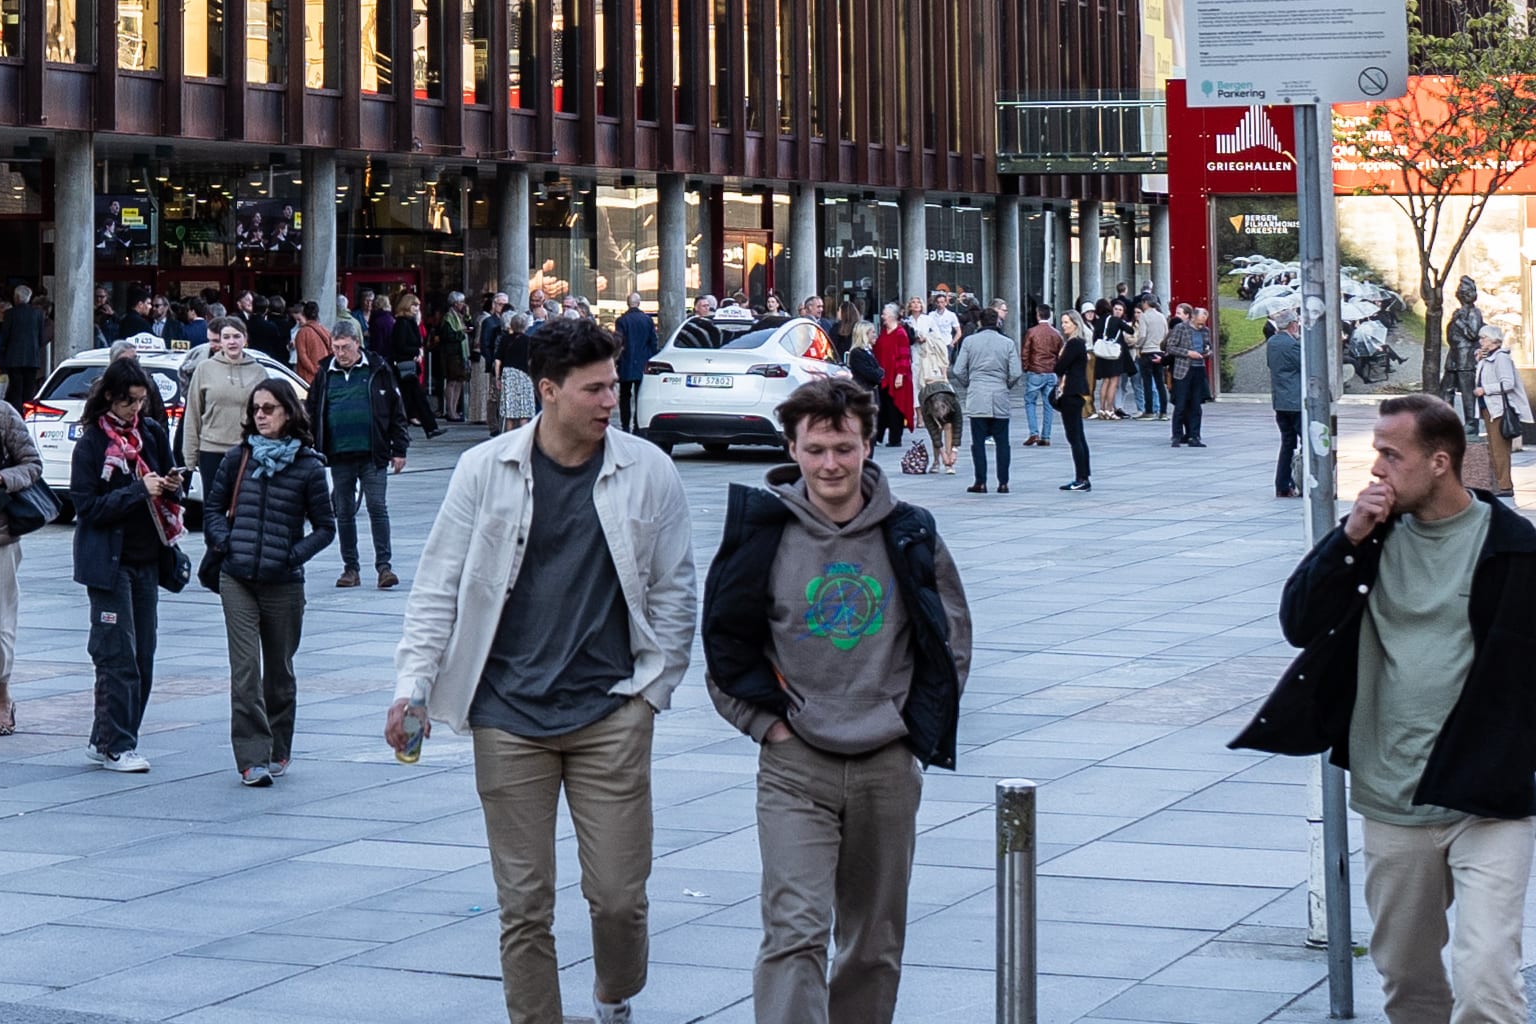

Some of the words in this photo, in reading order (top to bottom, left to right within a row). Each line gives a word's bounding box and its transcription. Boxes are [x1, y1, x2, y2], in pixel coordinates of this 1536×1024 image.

[1217, 80, 1253, 90] Bergen
[1217, 89, 1266, 99] Parkering
[1206, 161, 1292, 171] GRIEGHALLEN
[1244, 214, 1278, 222] BERGEN
[1244, 227, 1289, 235] ORKESTER
